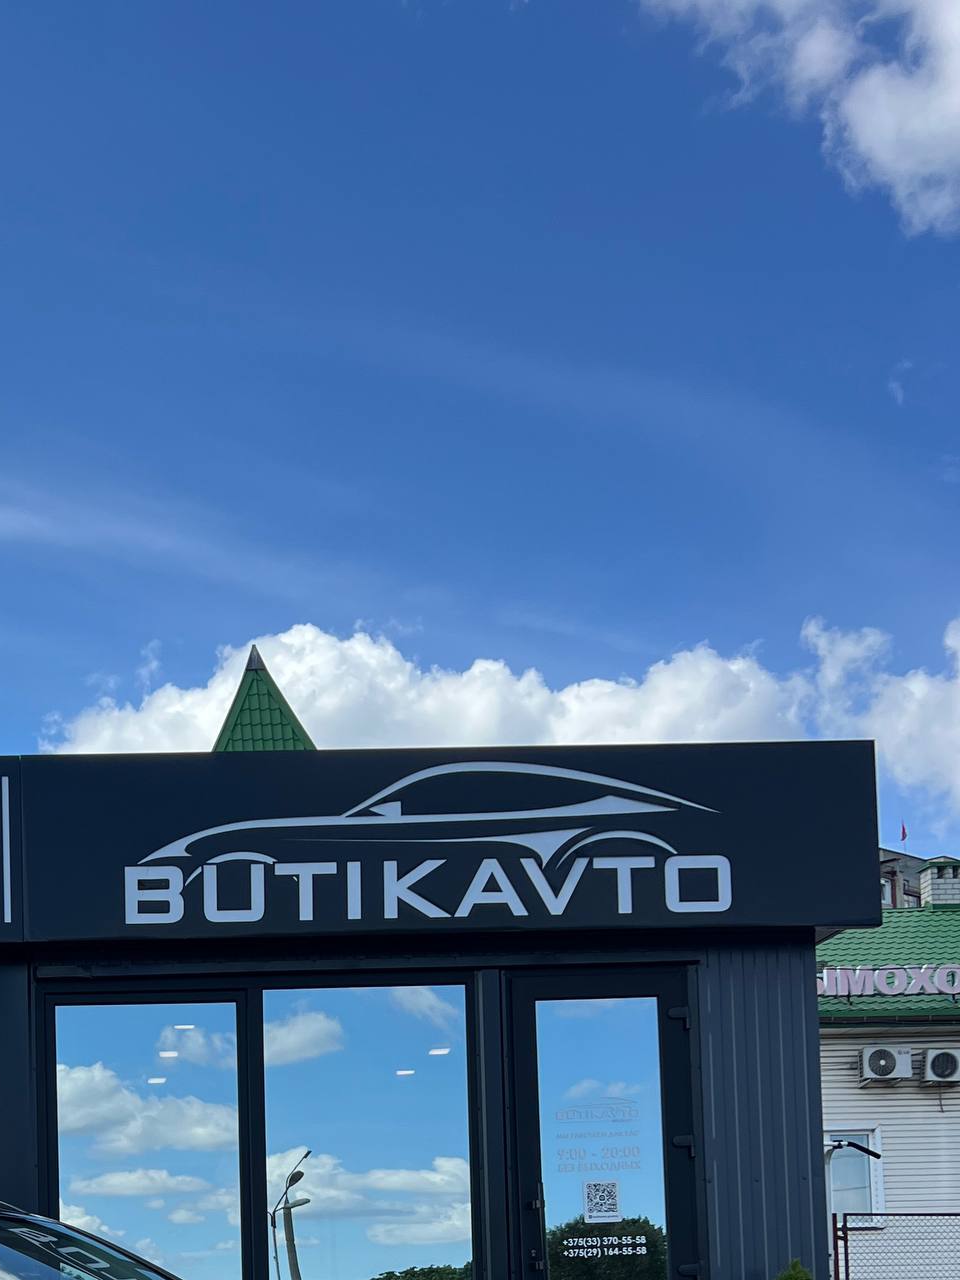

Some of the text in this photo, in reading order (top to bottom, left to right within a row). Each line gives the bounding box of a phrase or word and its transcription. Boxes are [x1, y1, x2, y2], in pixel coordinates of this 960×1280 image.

[124, 853, 732, 925] BUTIKAVTO
[562, 1235, 647, 1248] +375(33) 370-55-58
[563, 1246, 648, 1259] +375(29) 164-55-58
